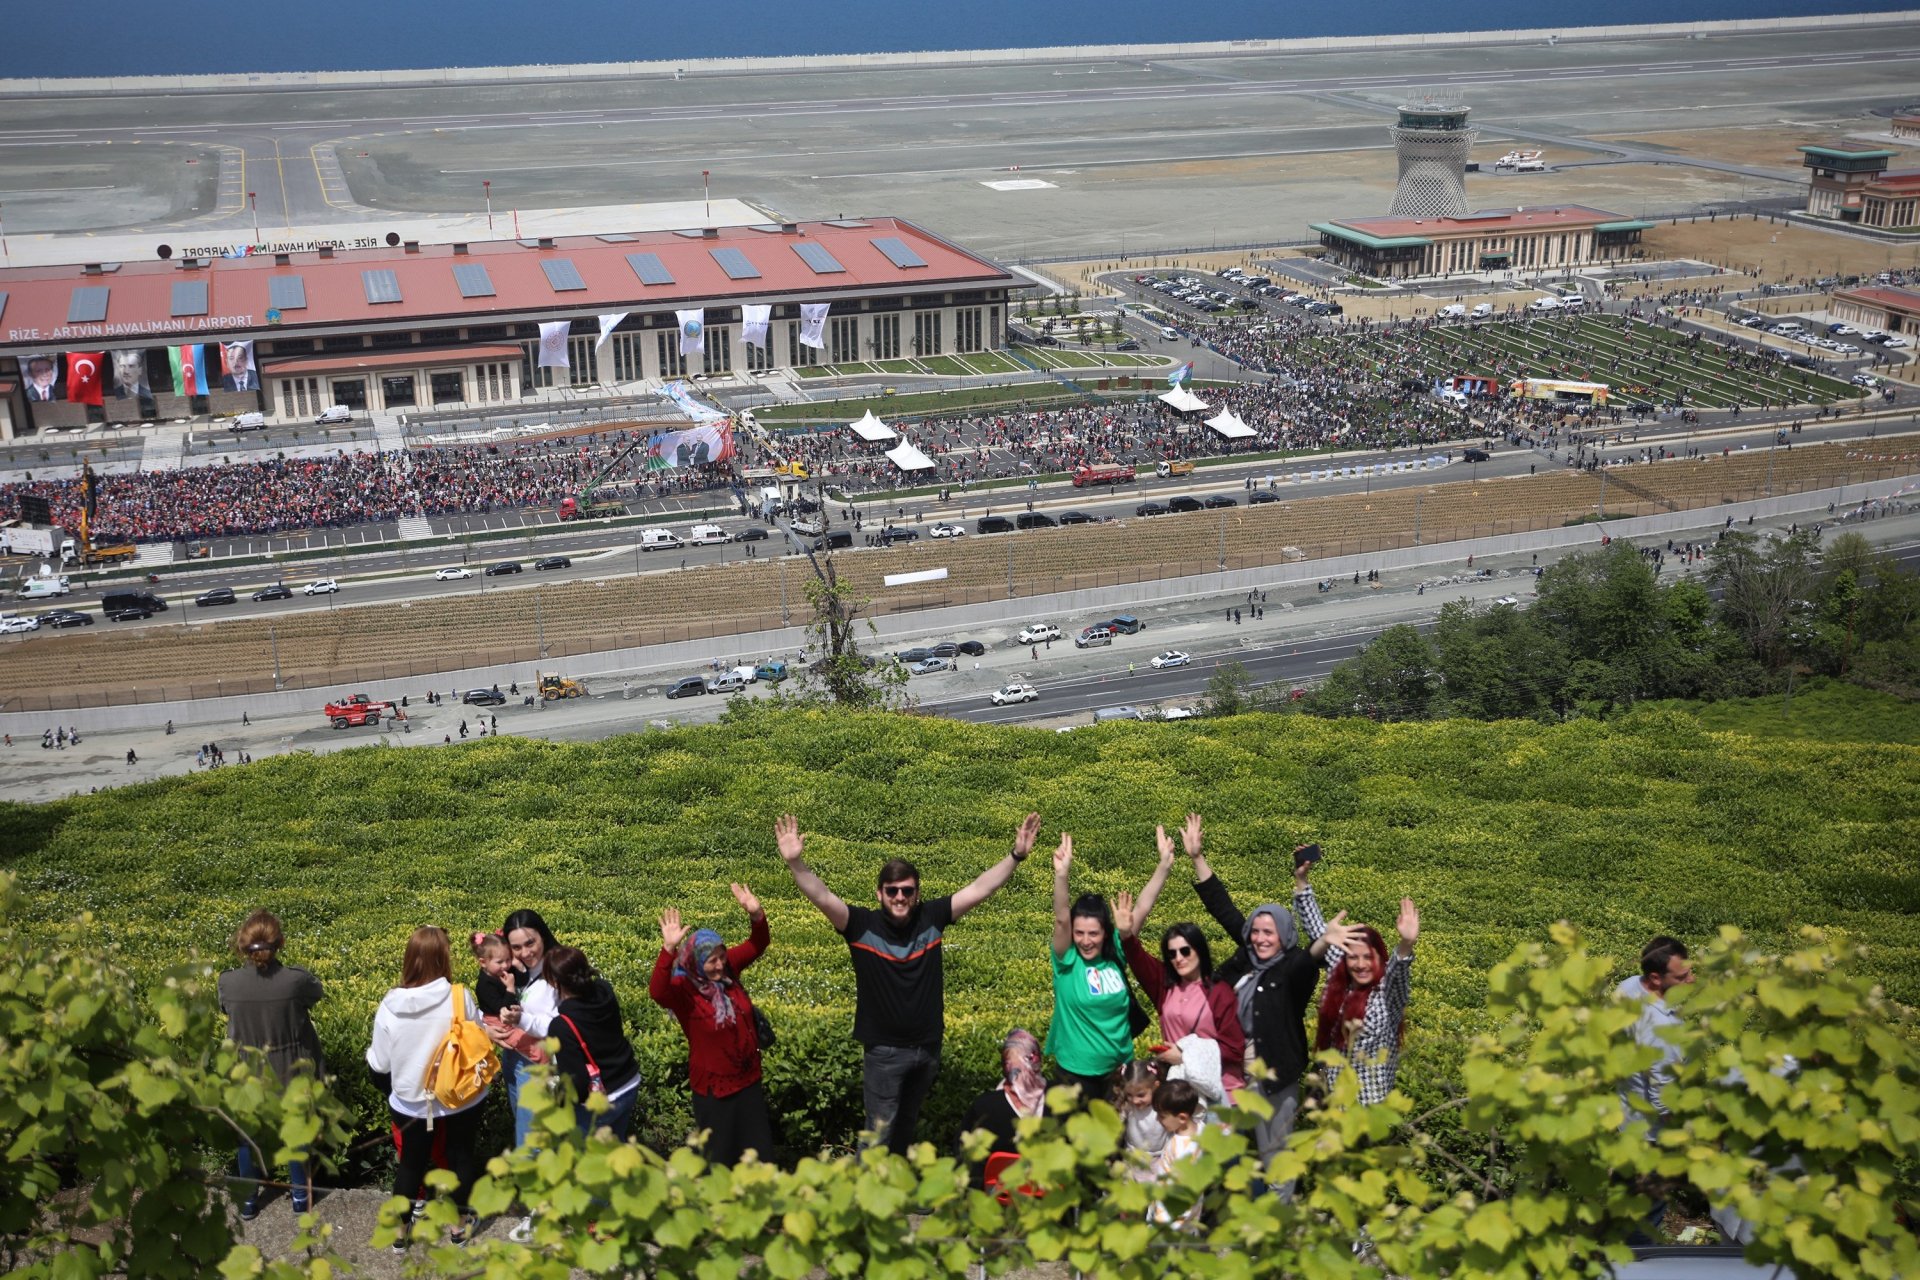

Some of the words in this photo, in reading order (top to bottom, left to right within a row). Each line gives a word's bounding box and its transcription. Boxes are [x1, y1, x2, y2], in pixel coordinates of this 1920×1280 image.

[9, 327, 40, 341] RİZE
[53, 323, 101, 338] ARTVİN
[105, 319, 185, 334] HAVALİMANI
[198, 315, 253, 328] AIRPORT
